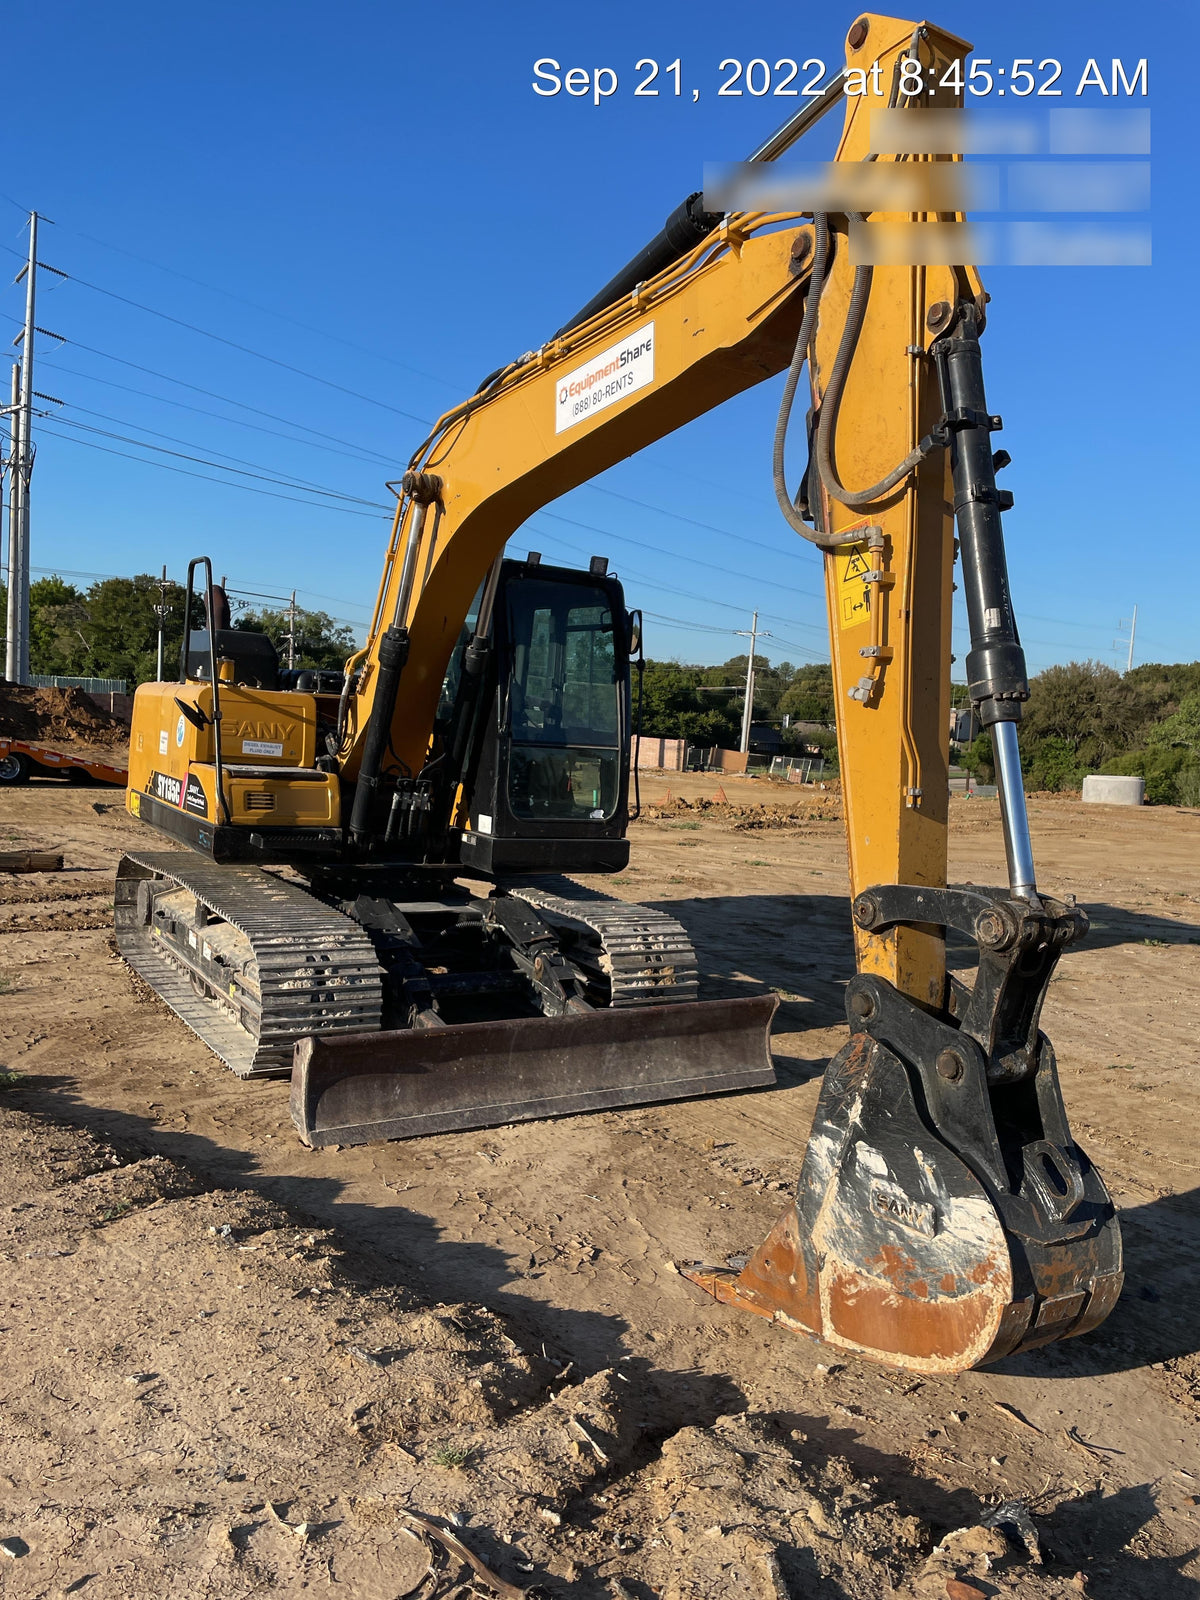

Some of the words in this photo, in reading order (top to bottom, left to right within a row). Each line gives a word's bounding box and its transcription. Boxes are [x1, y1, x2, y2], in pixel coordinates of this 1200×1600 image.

[569, 339, 652, 398] EquipmentShare
[573, 396, 591, 417] (888)
[593, 371, 634, 405] 80-RENTS
[221, 719, 296, 741] SANY
[876, 1193, 925, 1226] SANY
